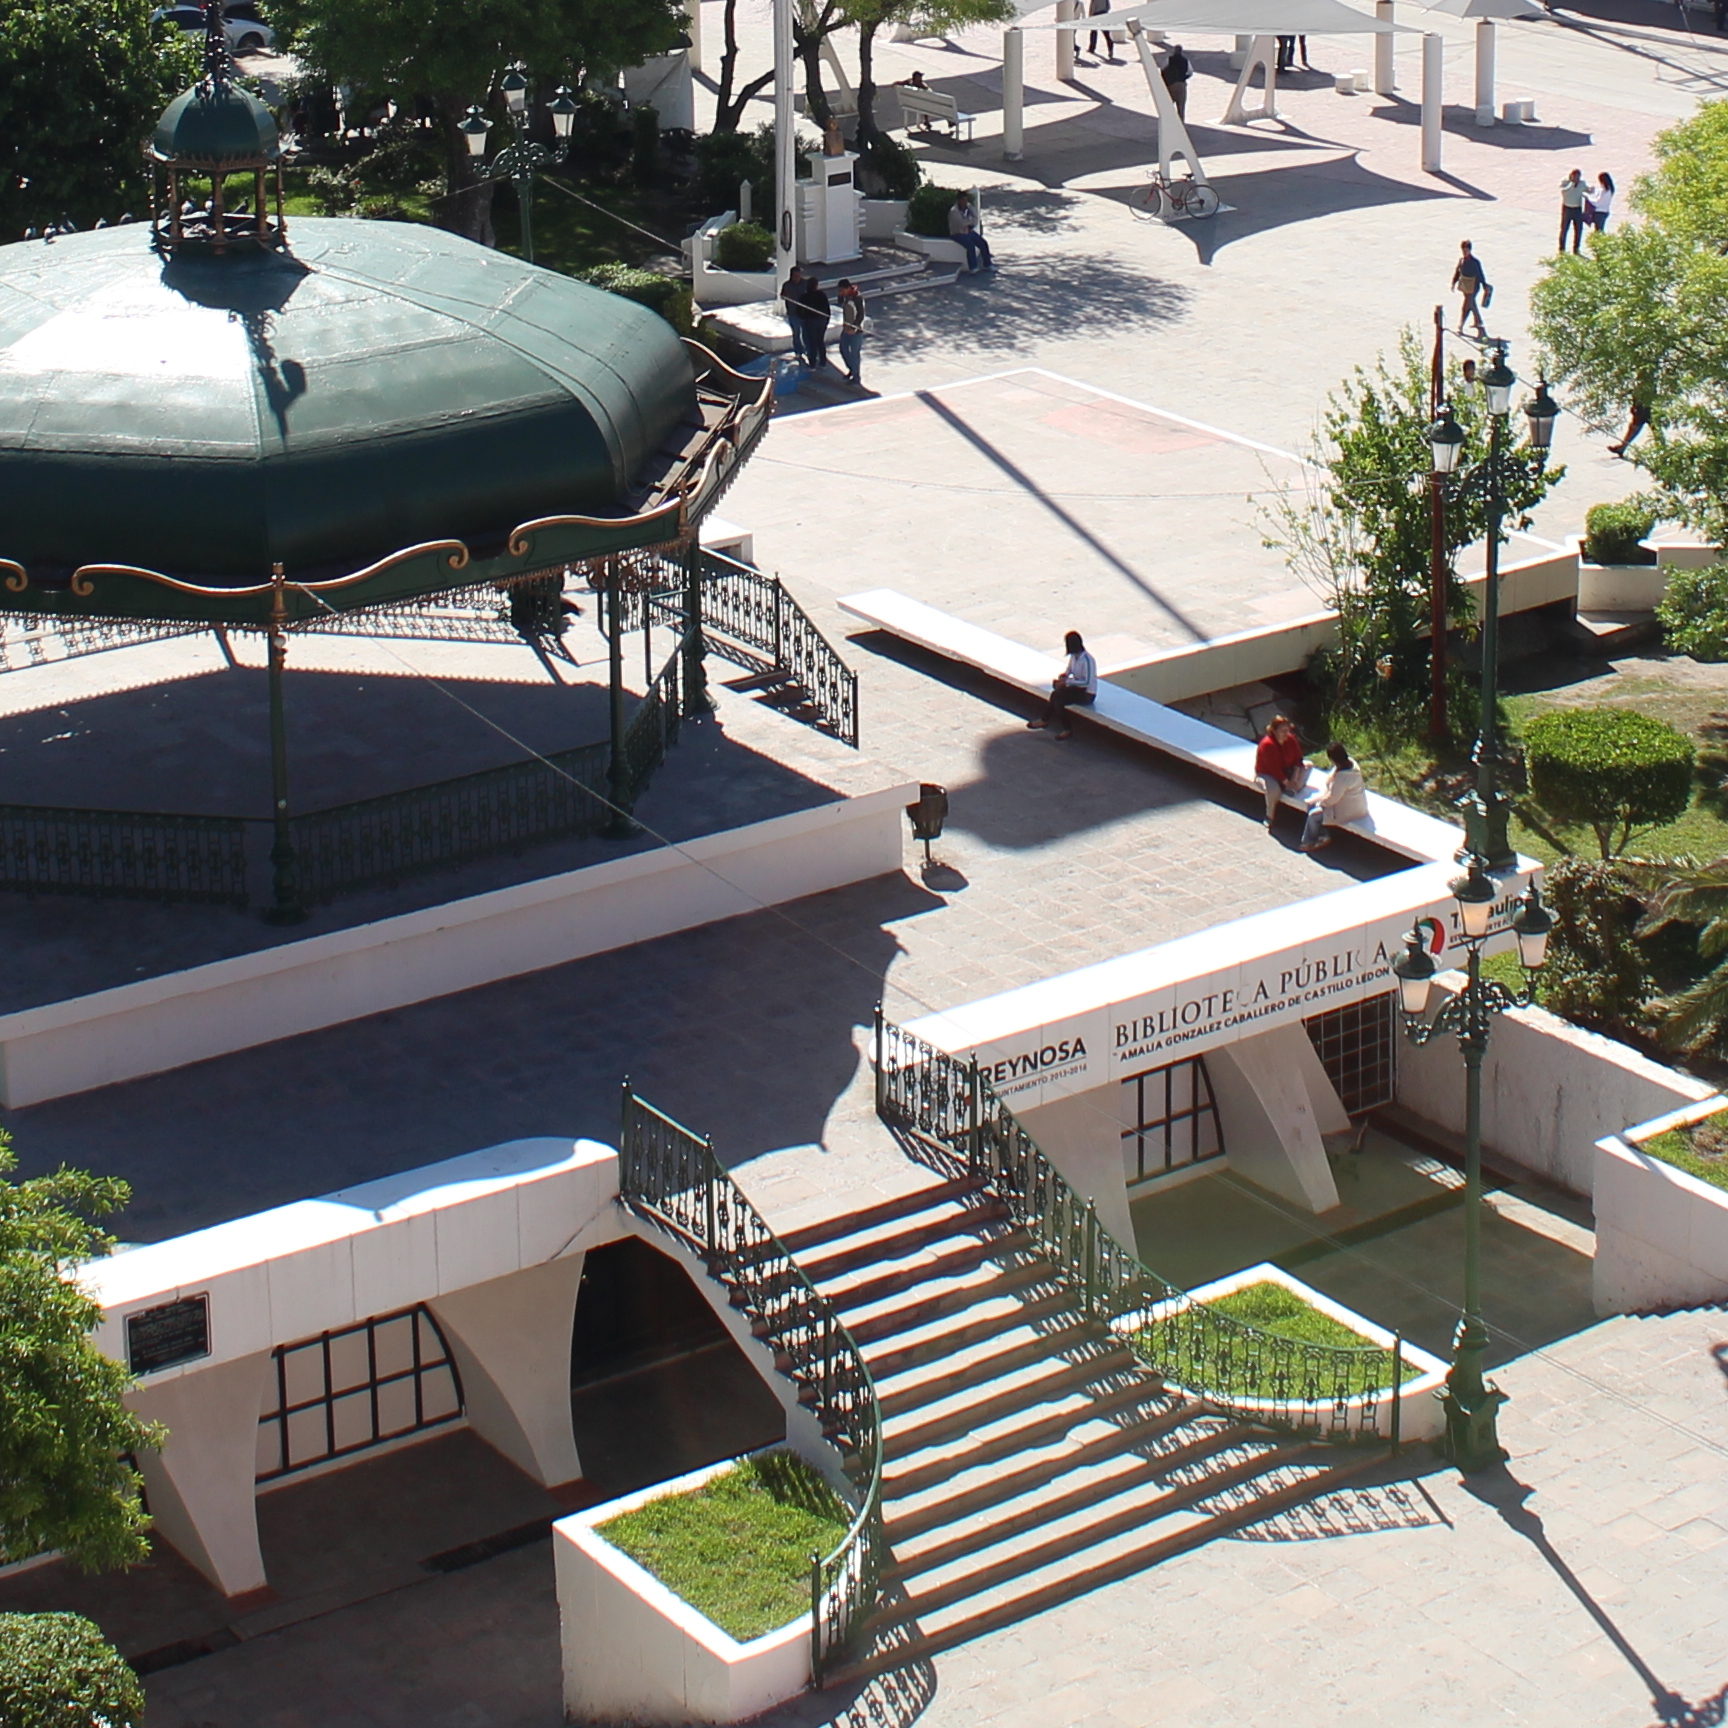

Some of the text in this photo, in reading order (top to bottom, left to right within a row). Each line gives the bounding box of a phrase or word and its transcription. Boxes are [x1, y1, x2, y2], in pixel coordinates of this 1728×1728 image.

[1165, 1020, 1222, 1047] GONZALEZ
[1223, 1001, 1286, 1029] CABALLERO
[1287, 994, 1302, 1008] DE
[1303, 979, 1354, 1003] CASTILLO
[979, 1037, 1087, 1085] REYNOSA
